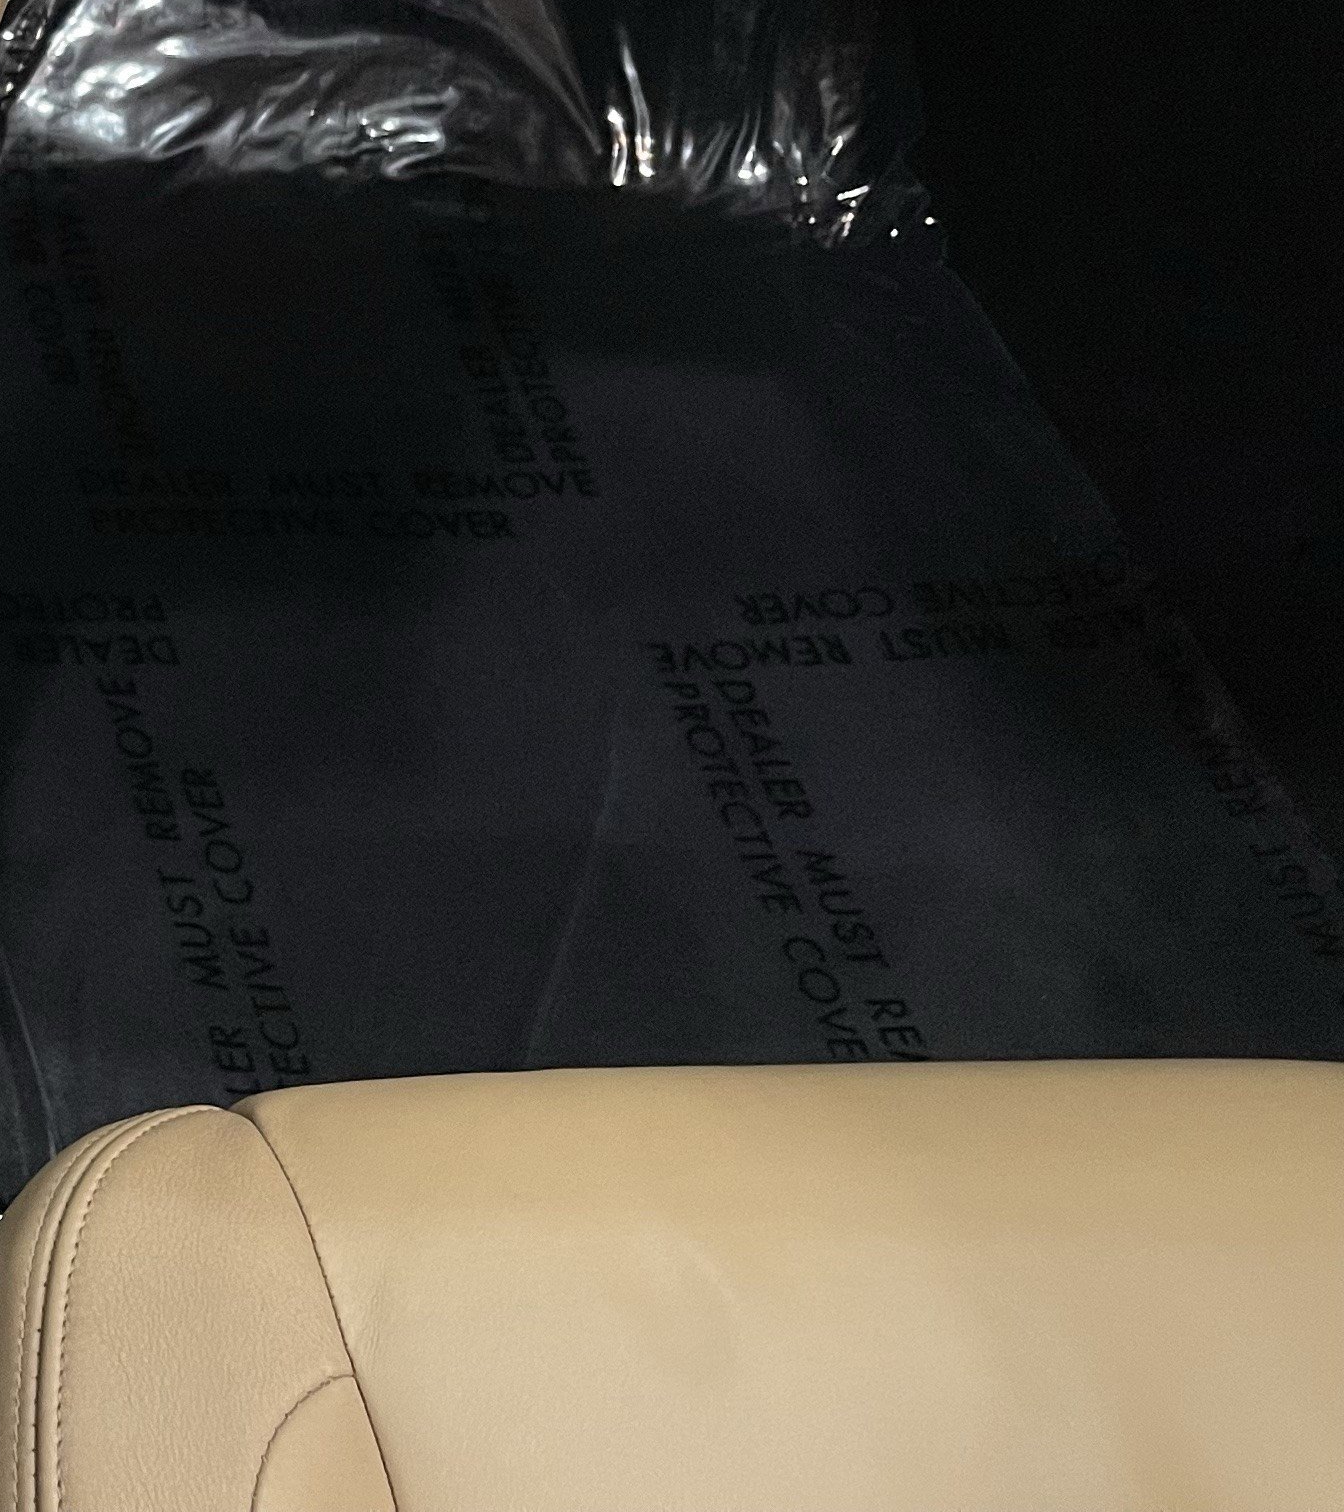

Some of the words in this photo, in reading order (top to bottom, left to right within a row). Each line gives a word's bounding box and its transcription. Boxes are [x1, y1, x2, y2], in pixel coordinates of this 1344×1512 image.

[646, 633, 853, 675] REMOVE
[733, 585, 896, 626] COVER
[96, 676, 182, 842] REMOVE
[712, 677, 815, 822] DEALER
[796, 848, 890, 971] MUST
[180, 766, 255, 906] COVER
[661, 679, 805, 916] PROTECTIVE
[781, 934, 872, 1062] COVE
[157, 867, 229, 992] MUST
[229, 925, 311, 1080] ECTIVE
